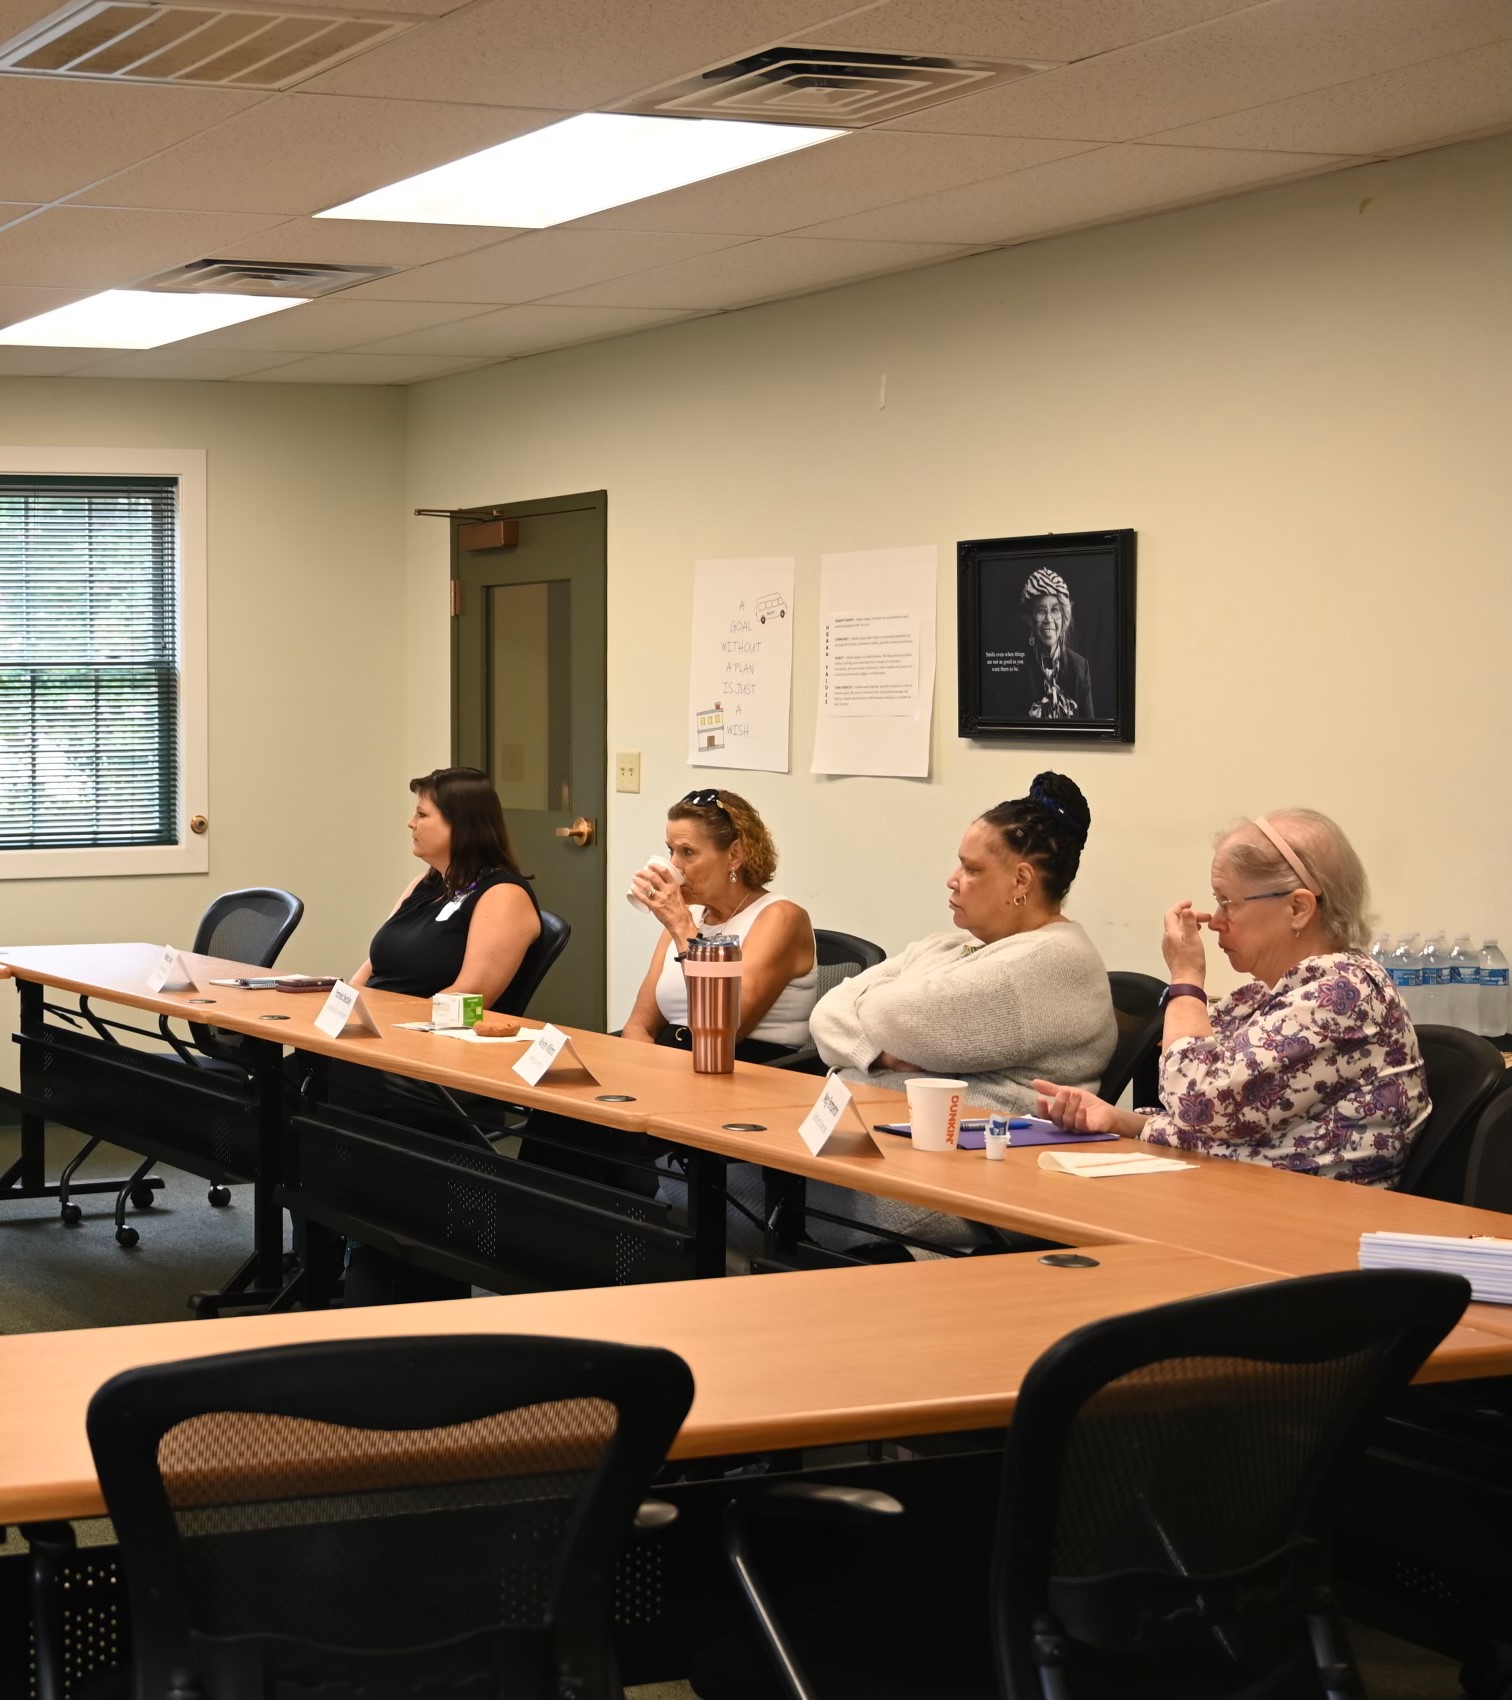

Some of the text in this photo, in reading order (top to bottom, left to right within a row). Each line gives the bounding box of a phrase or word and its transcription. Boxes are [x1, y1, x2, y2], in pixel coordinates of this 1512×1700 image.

[739, 600, 745, 612] A
[730, 620, 752, 633] GOAL
[721, 640, 761, 653] WITHOUT
[726, 662, 754, 674] A PLAN
[723, 681, 756, 695] IS JUST
[736, 704, 741, 716] A
[727, 723, 749, 736] WISH
